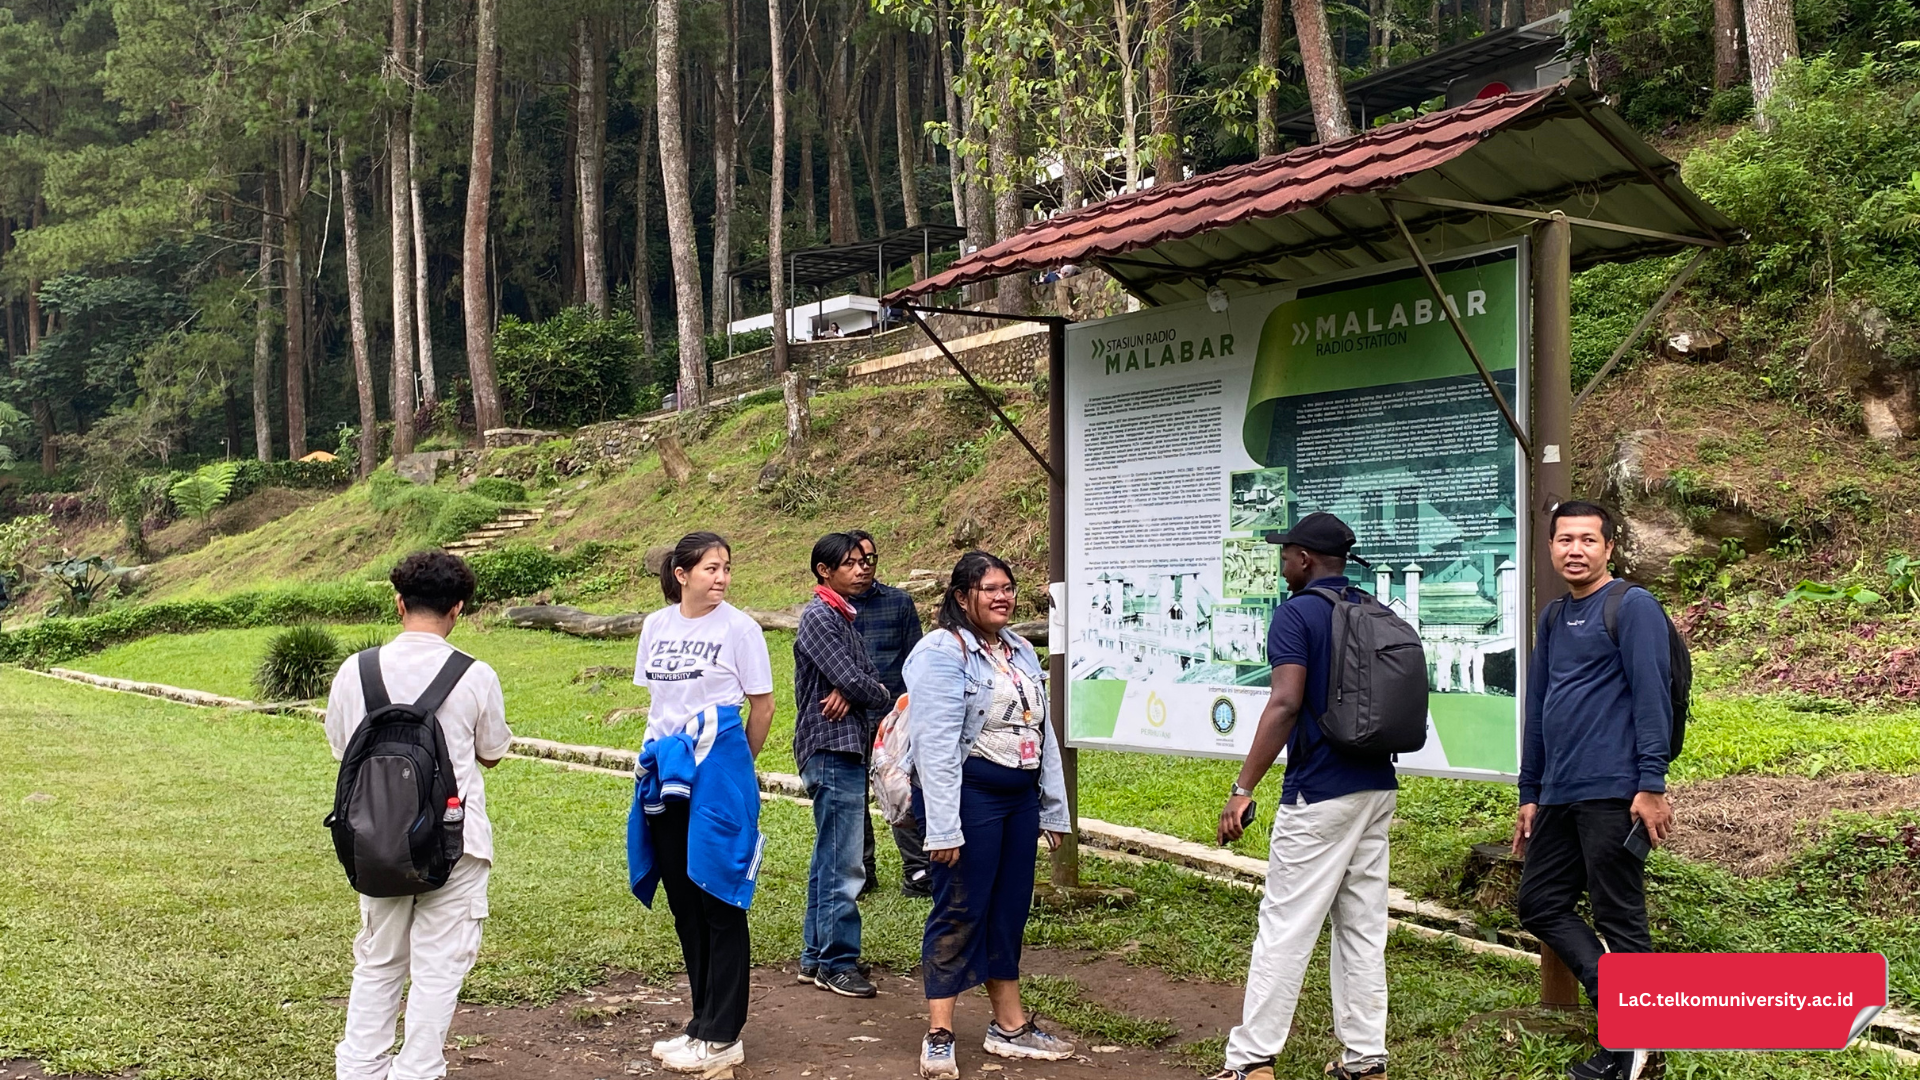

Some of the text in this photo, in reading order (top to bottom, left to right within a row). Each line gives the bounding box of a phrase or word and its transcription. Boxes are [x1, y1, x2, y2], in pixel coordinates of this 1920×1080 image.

[1315, 289, 1487, 341] MALABAR
[1106, 328, 1176, 353] STASIUN RADIO
[1316, 330, 1407, 357] RADIO STATION
[1105, 333, 1235, 376] MALABAR
[651, 672, 691, 681] UNIVERSITY
